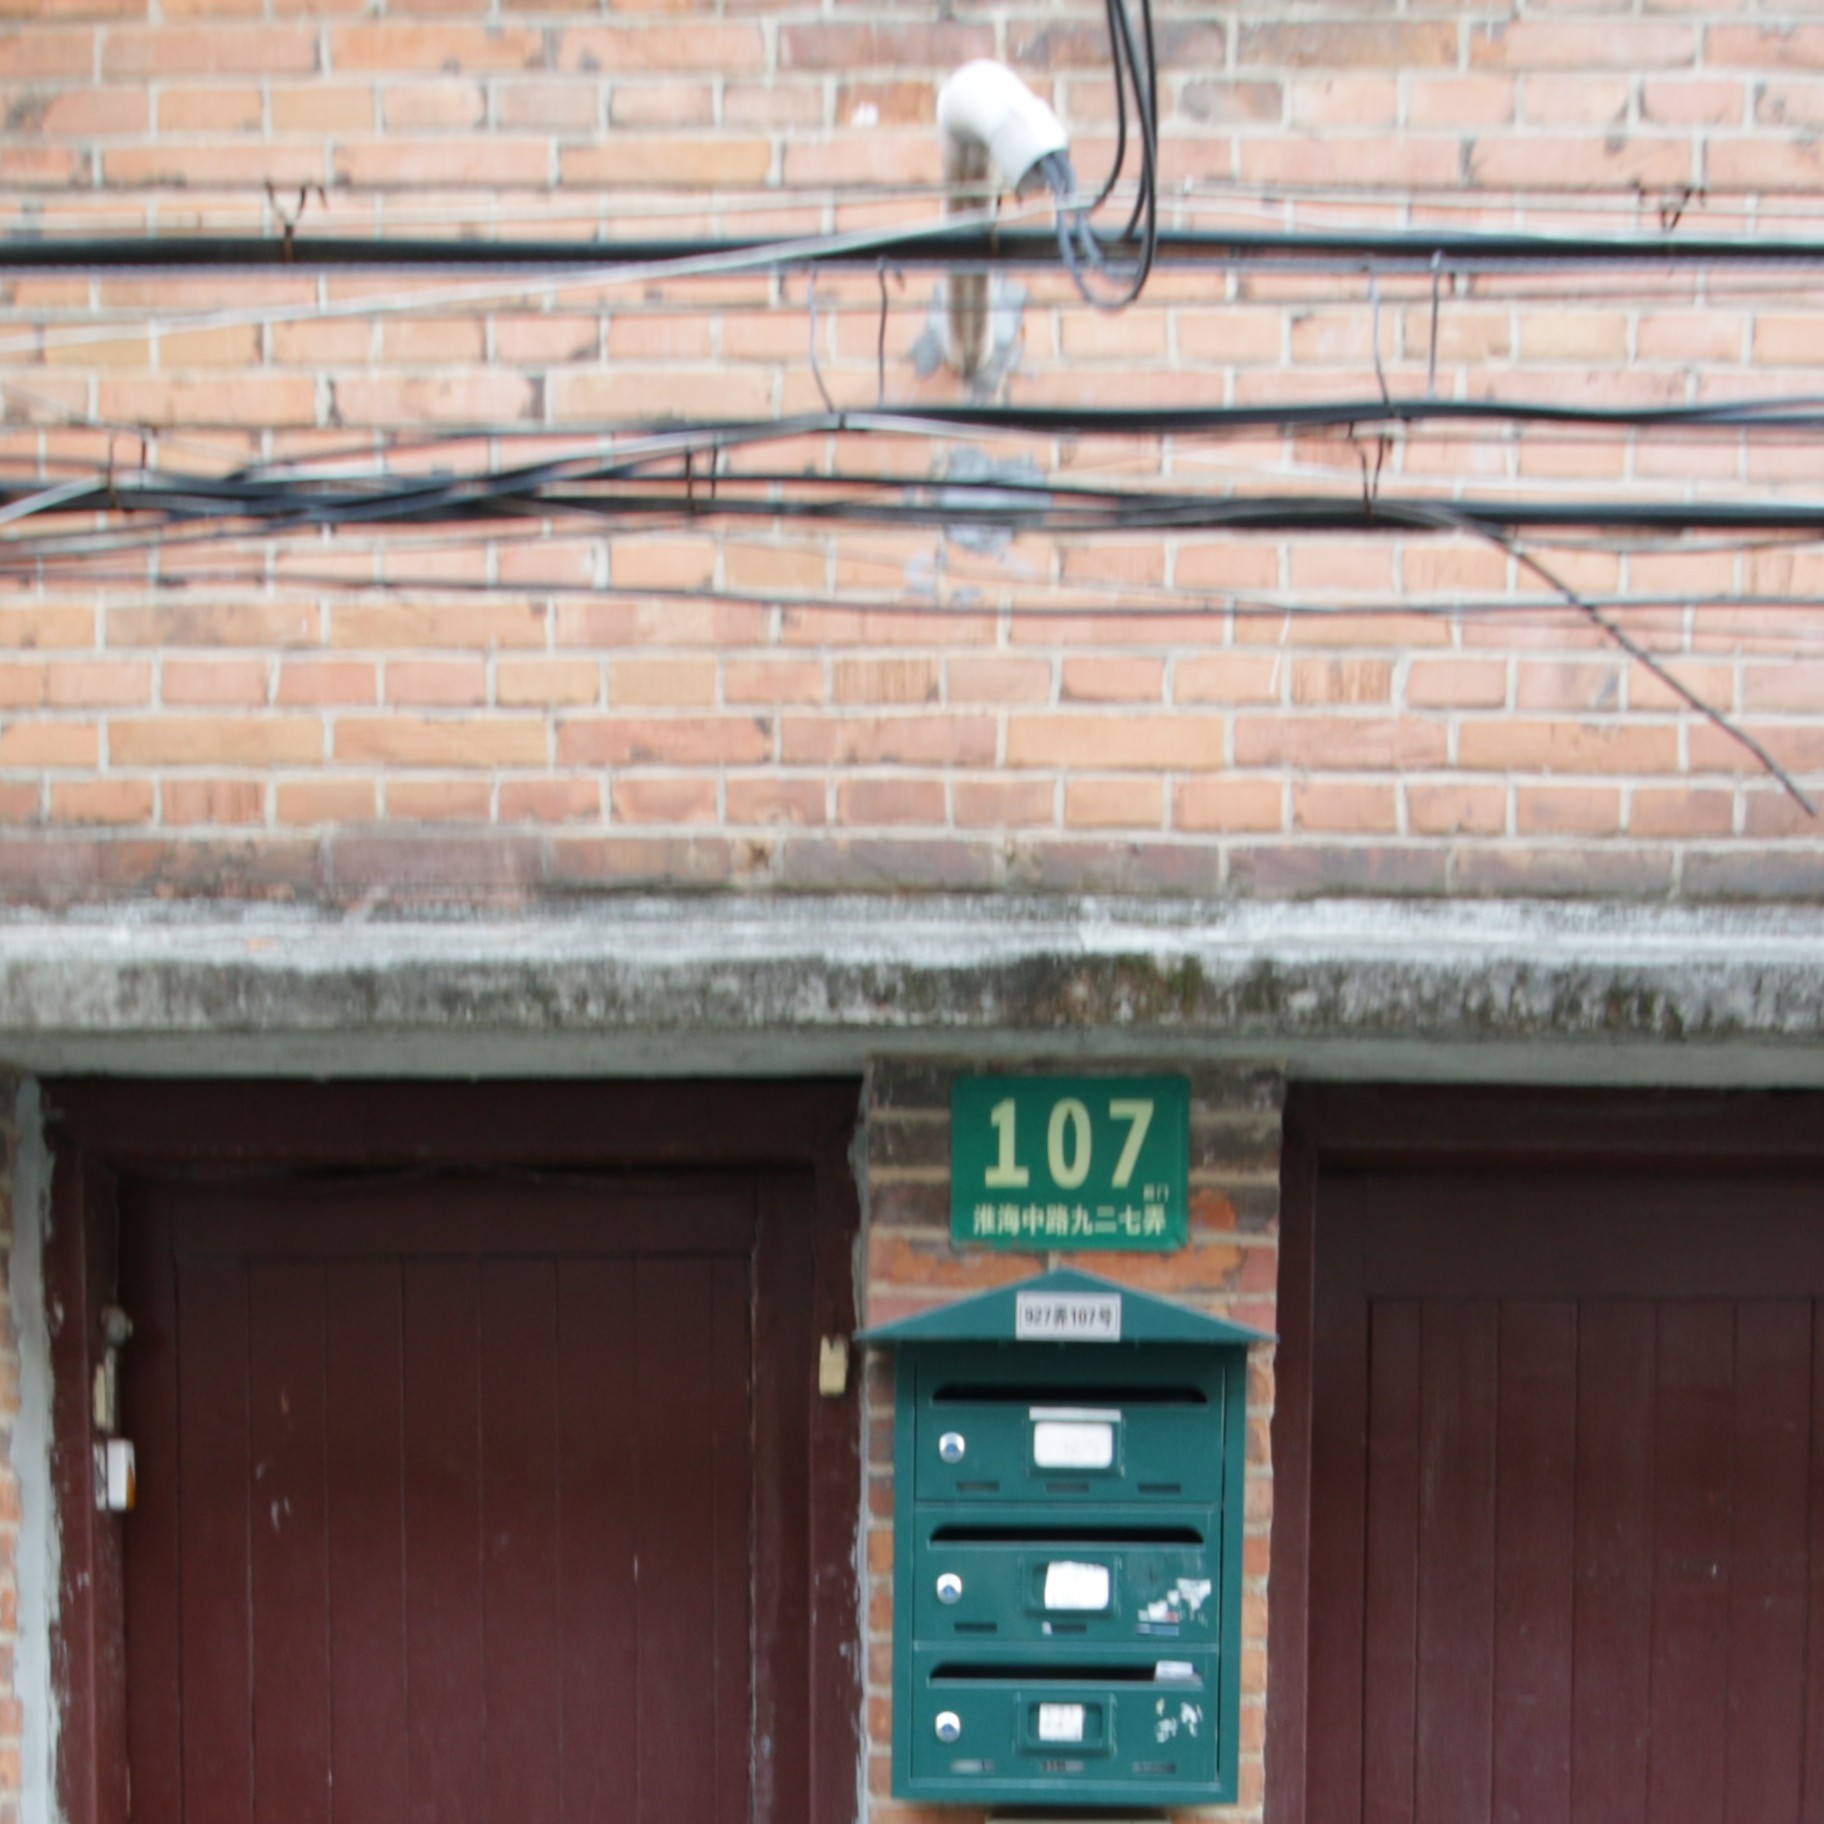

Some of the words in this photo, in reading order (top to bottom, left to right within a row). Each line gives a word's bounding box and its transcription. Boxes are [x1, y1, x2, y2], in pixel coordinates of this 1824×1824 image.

[983, 1097, 1155, 1190] 107
[973, 1203, 1167, 1237] 淮海中路九二七弄
[1024, 1303, 1112, 1330] 927弄107号
